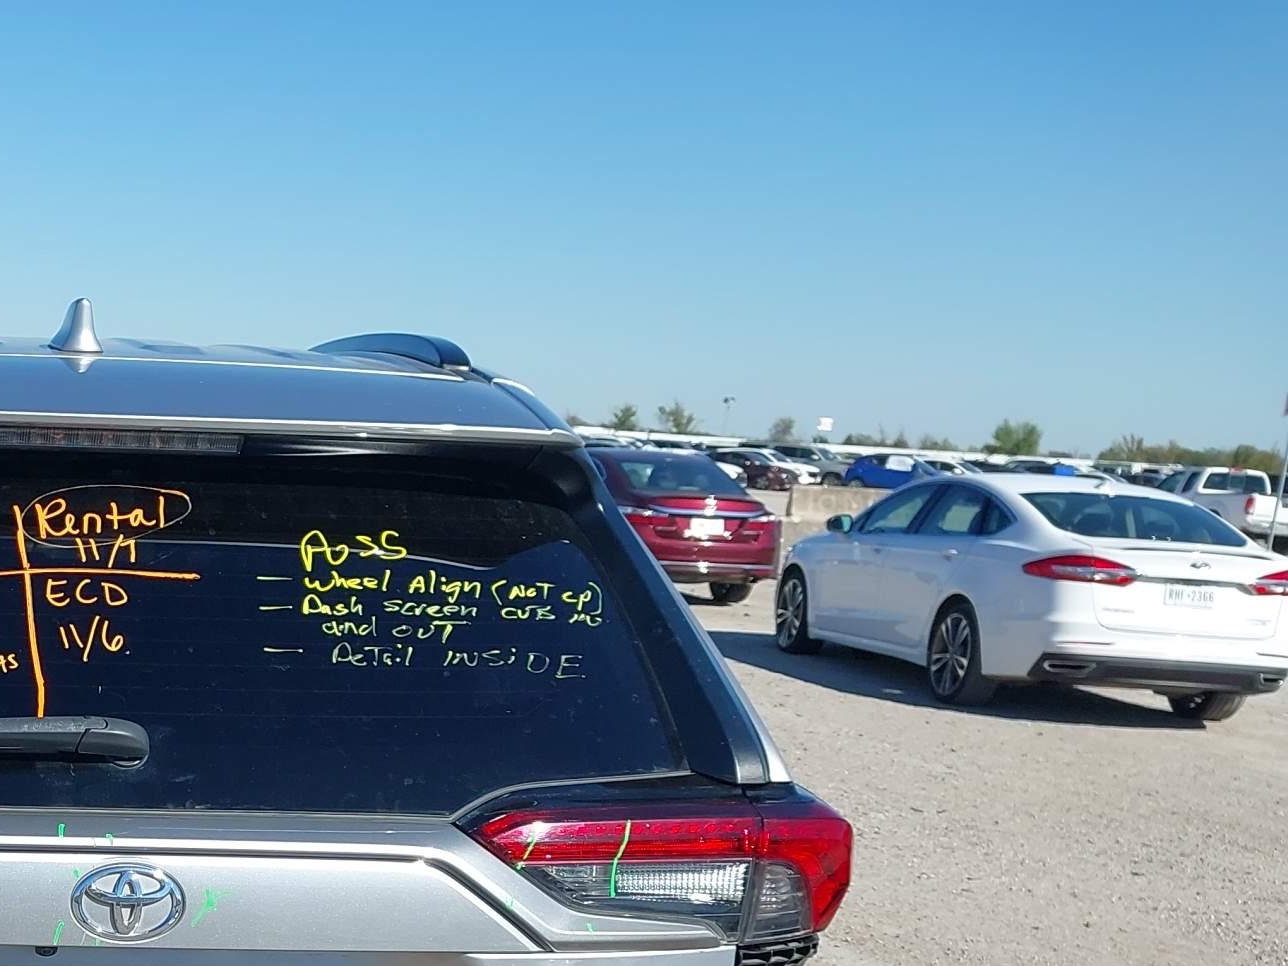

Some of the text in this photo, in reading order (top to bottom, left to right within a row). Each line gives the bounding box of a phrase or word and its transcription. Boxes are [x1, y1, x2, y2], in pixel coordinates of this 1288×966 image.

[34, 495, 165, 540] Rental
[75, 534, 137, 569] 11/7
[45, 578, 129, 607] ECD
[409, 569, 482, 602] Align
[59, 615, 125, 662] 11/6
